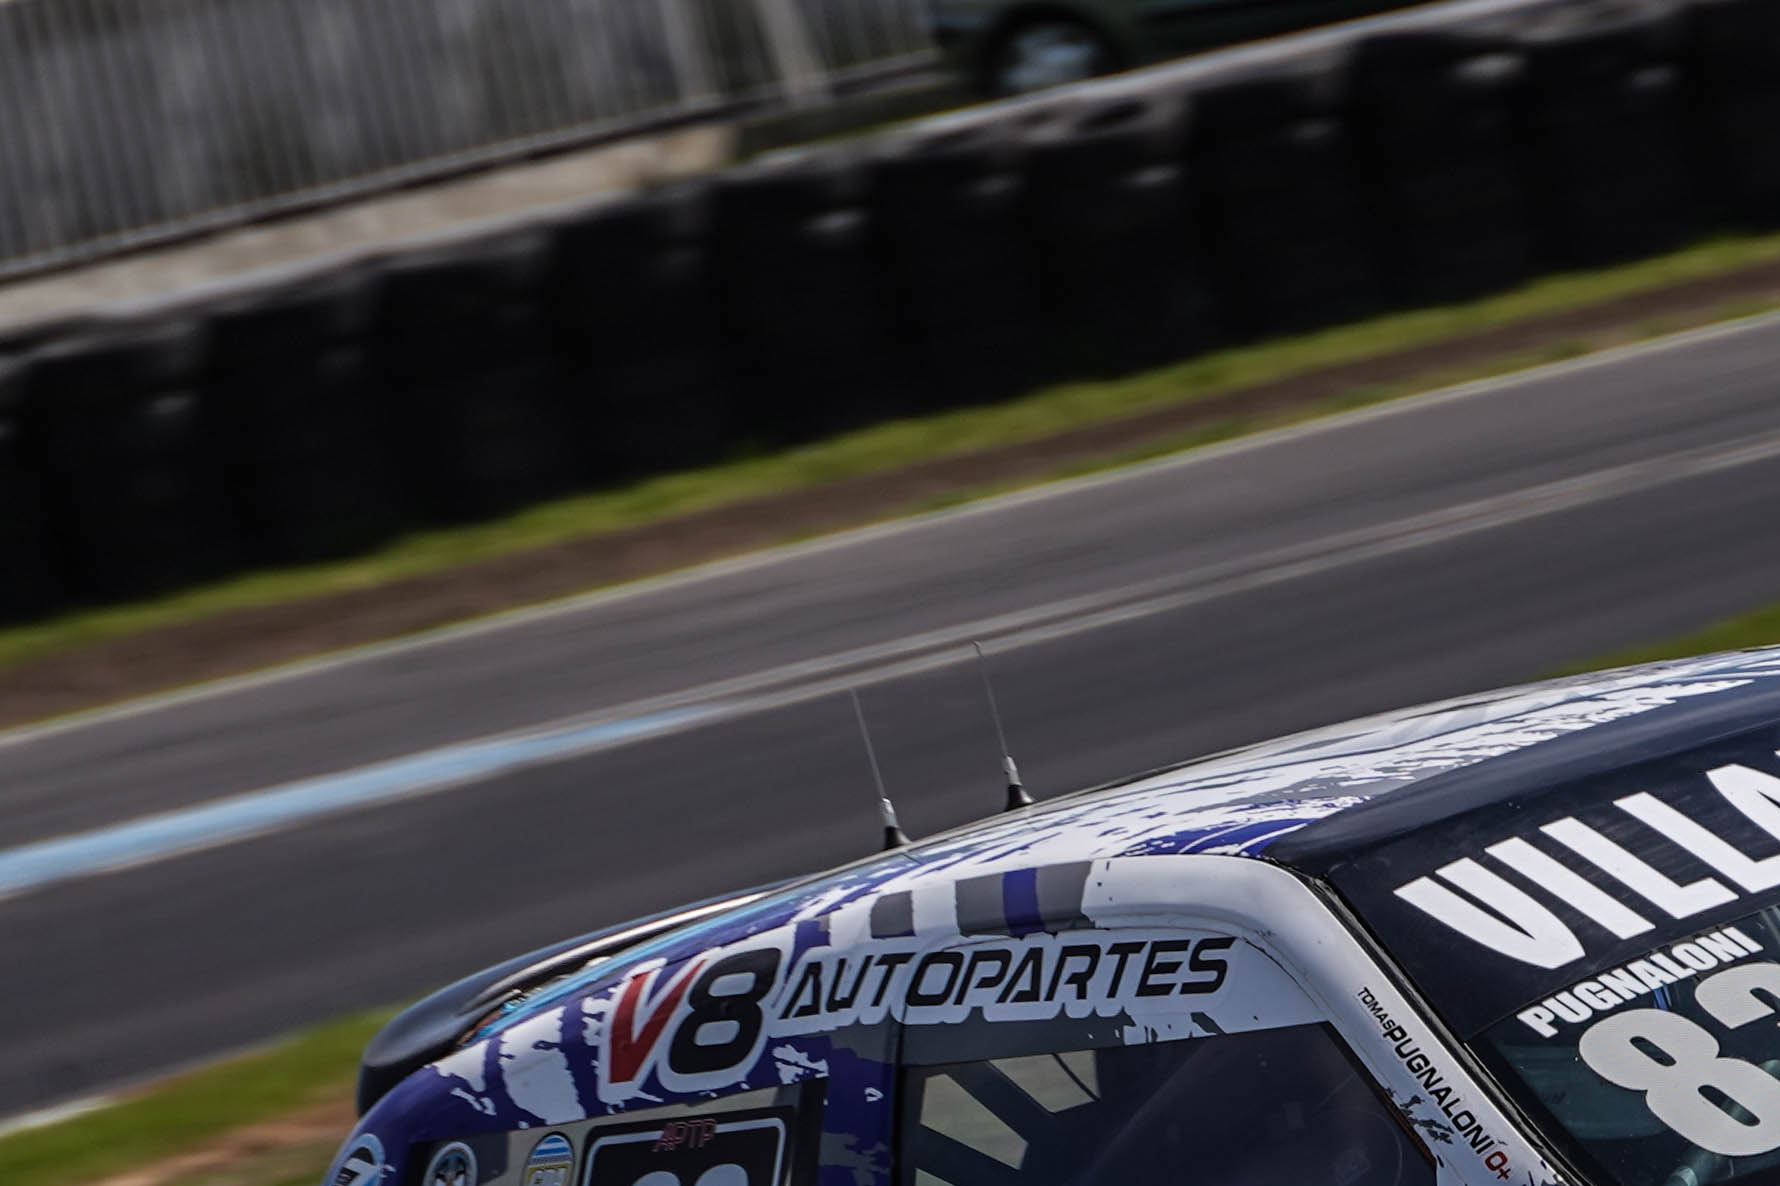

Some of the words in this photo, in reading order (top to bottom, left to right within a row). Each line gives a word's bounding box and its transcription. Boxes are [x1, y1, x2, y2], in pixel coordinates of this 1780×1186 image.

[608, 945, 781, 1084] V8
[778, 937, 1237, 1019] AUTOPARTES
[1516, 927, 1764, 1038] PUGNALONI
[1358, 987, 1395, 1031] TOMAS
[1383, 1025, 1494, 1155] PUGNALONI
